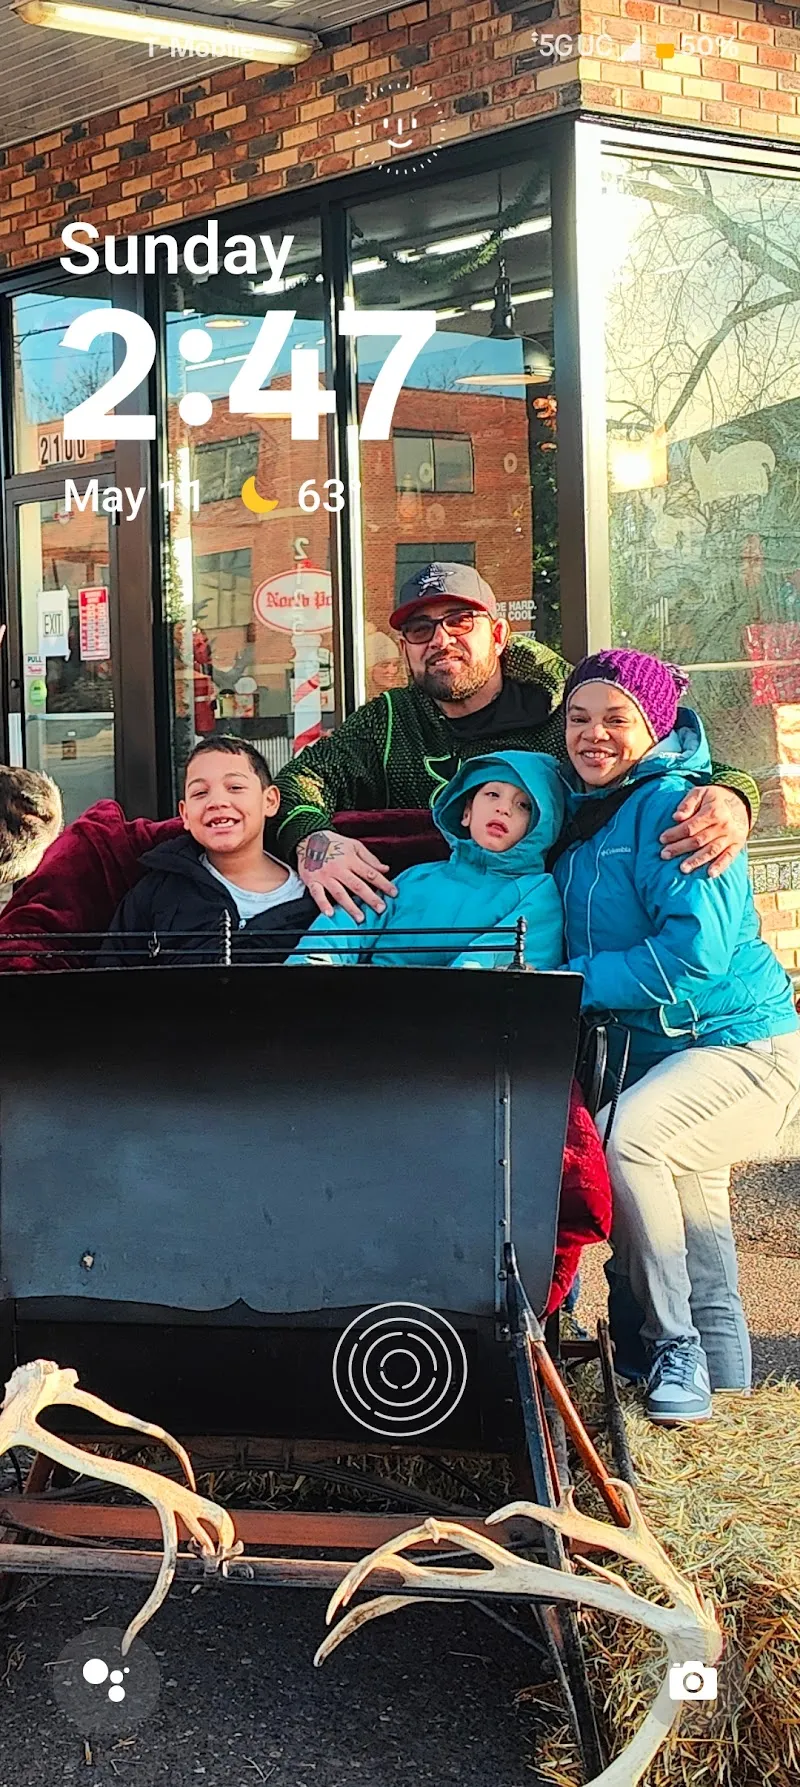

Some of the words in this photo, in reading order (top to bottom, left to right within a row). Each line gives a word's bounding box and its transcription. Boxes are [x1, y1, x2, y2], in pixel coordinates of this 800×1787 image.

[40, 434, 86, 465] 2100
[508, 600, 537, 611] HARD.
[44, 613, 62, 635] EXIT
[27, 655, 43, 663] PULL
